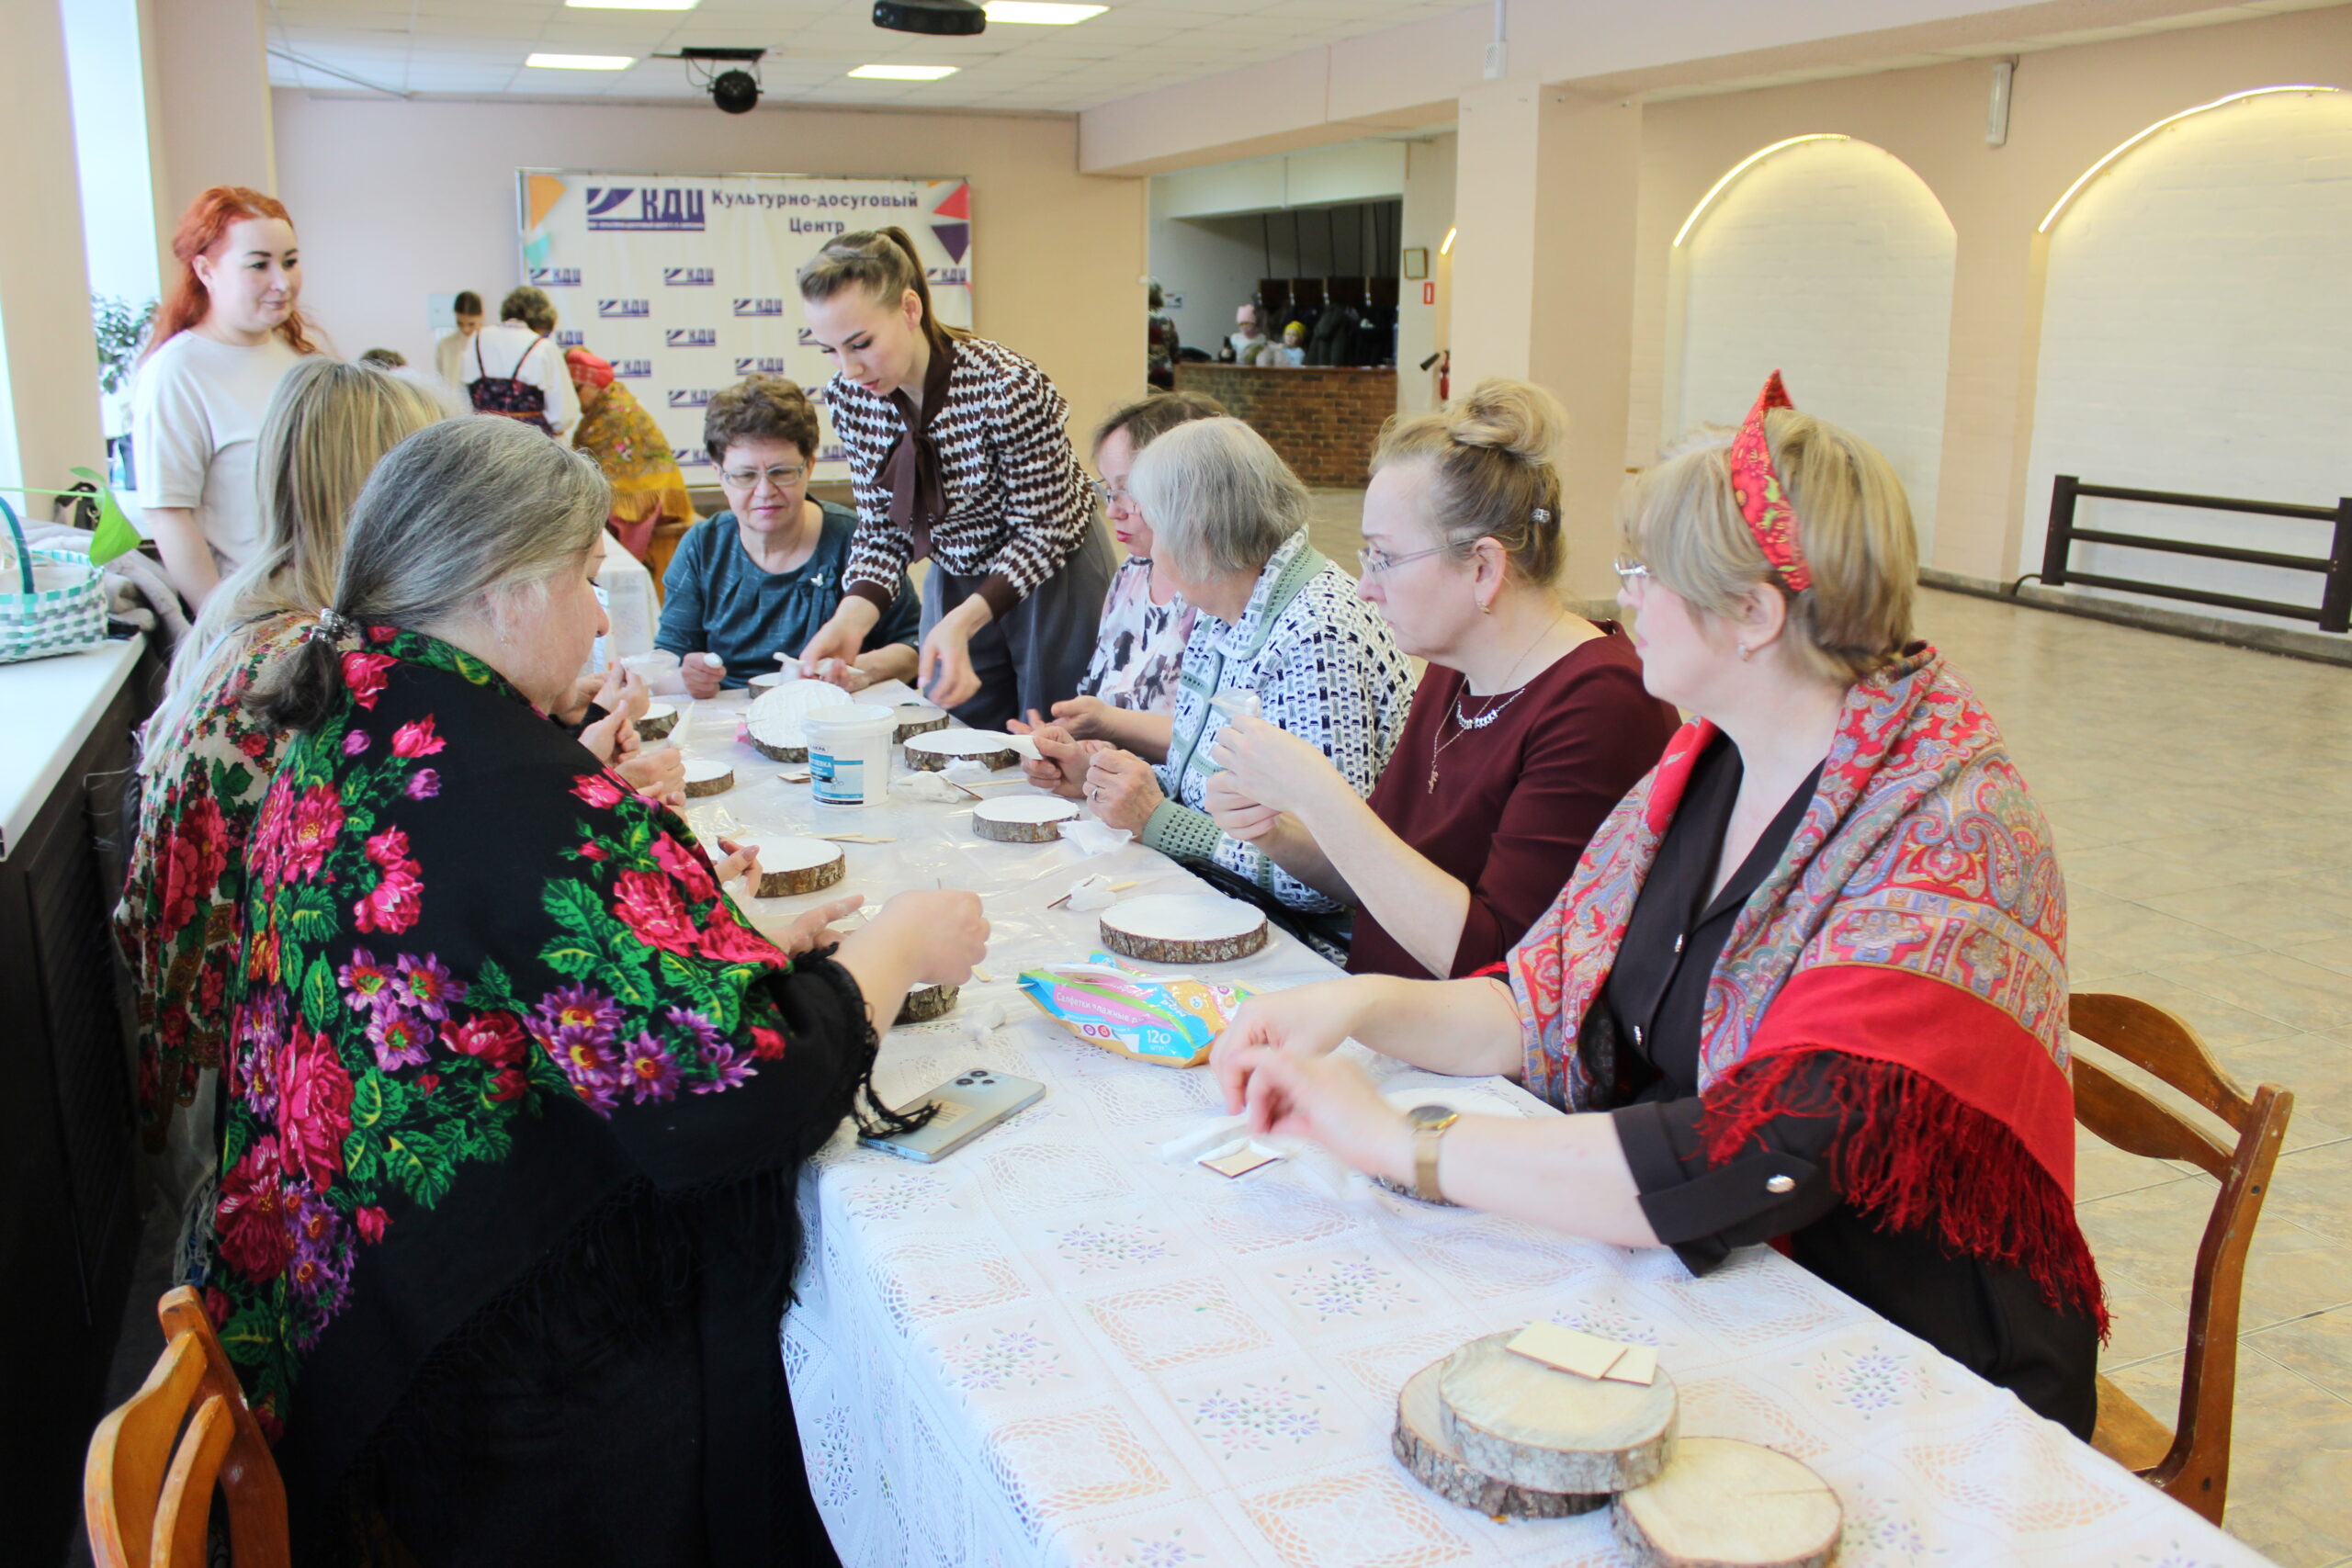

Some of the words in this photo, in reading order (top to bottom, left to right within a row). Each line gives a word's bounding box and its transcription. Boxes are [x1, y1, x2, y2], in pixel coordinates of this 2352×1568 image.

[641, 188, 705, 221] КДЦ
[712, 190, 918, 210] Культурно-досуговый
[790, 218, 844, 234] Центр
[1057, 992, 1091, 1009] Салфетки
[1147, 1029, 1171, 1044] 120
